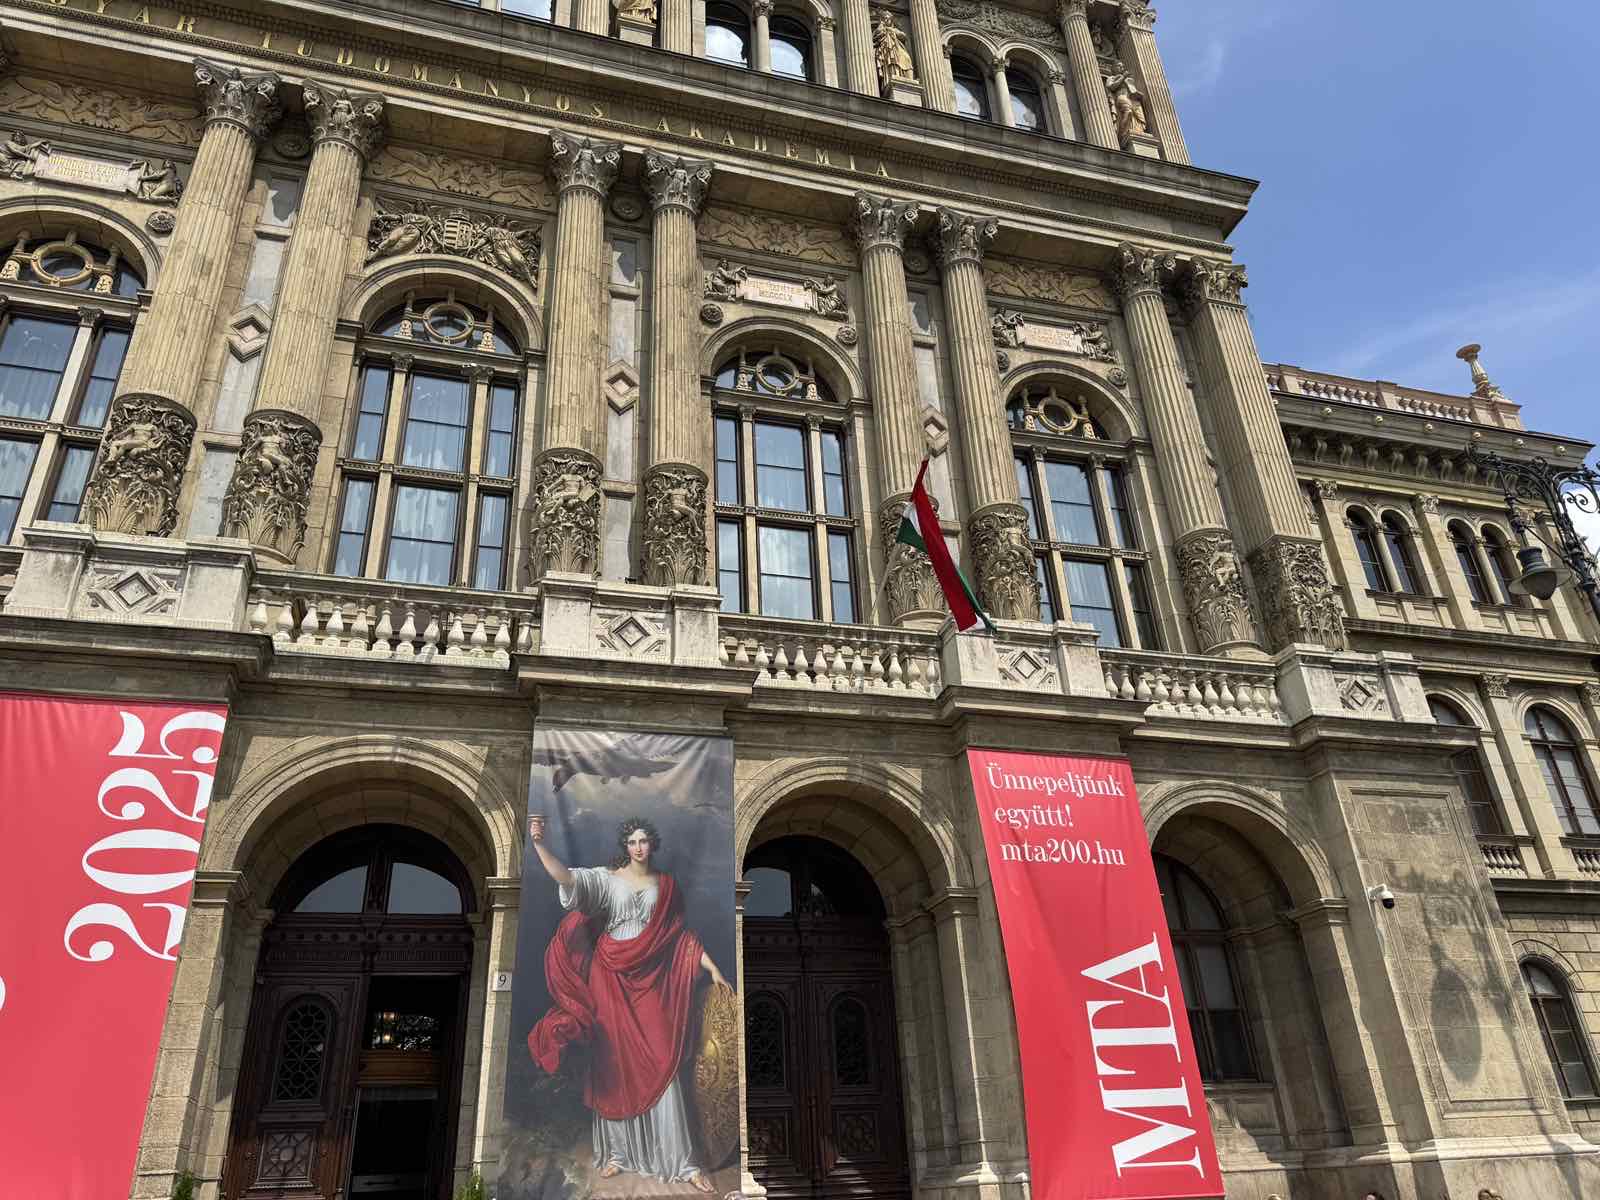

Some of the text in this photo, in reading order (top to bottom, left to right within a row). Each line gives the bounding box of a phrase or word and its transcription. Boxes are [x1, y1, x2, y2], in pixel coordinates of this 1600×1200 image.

[986, 762, 1125, 798] Ünnepeljünk
[994, 803, 1074, 830] együtt!
[63, 710, 228, 962] 2025
[1000, 838, 1126, 866] mta200.hu
[499, 974, 507, 986] 9
[1080, 931, 1205, 1179] MTA
